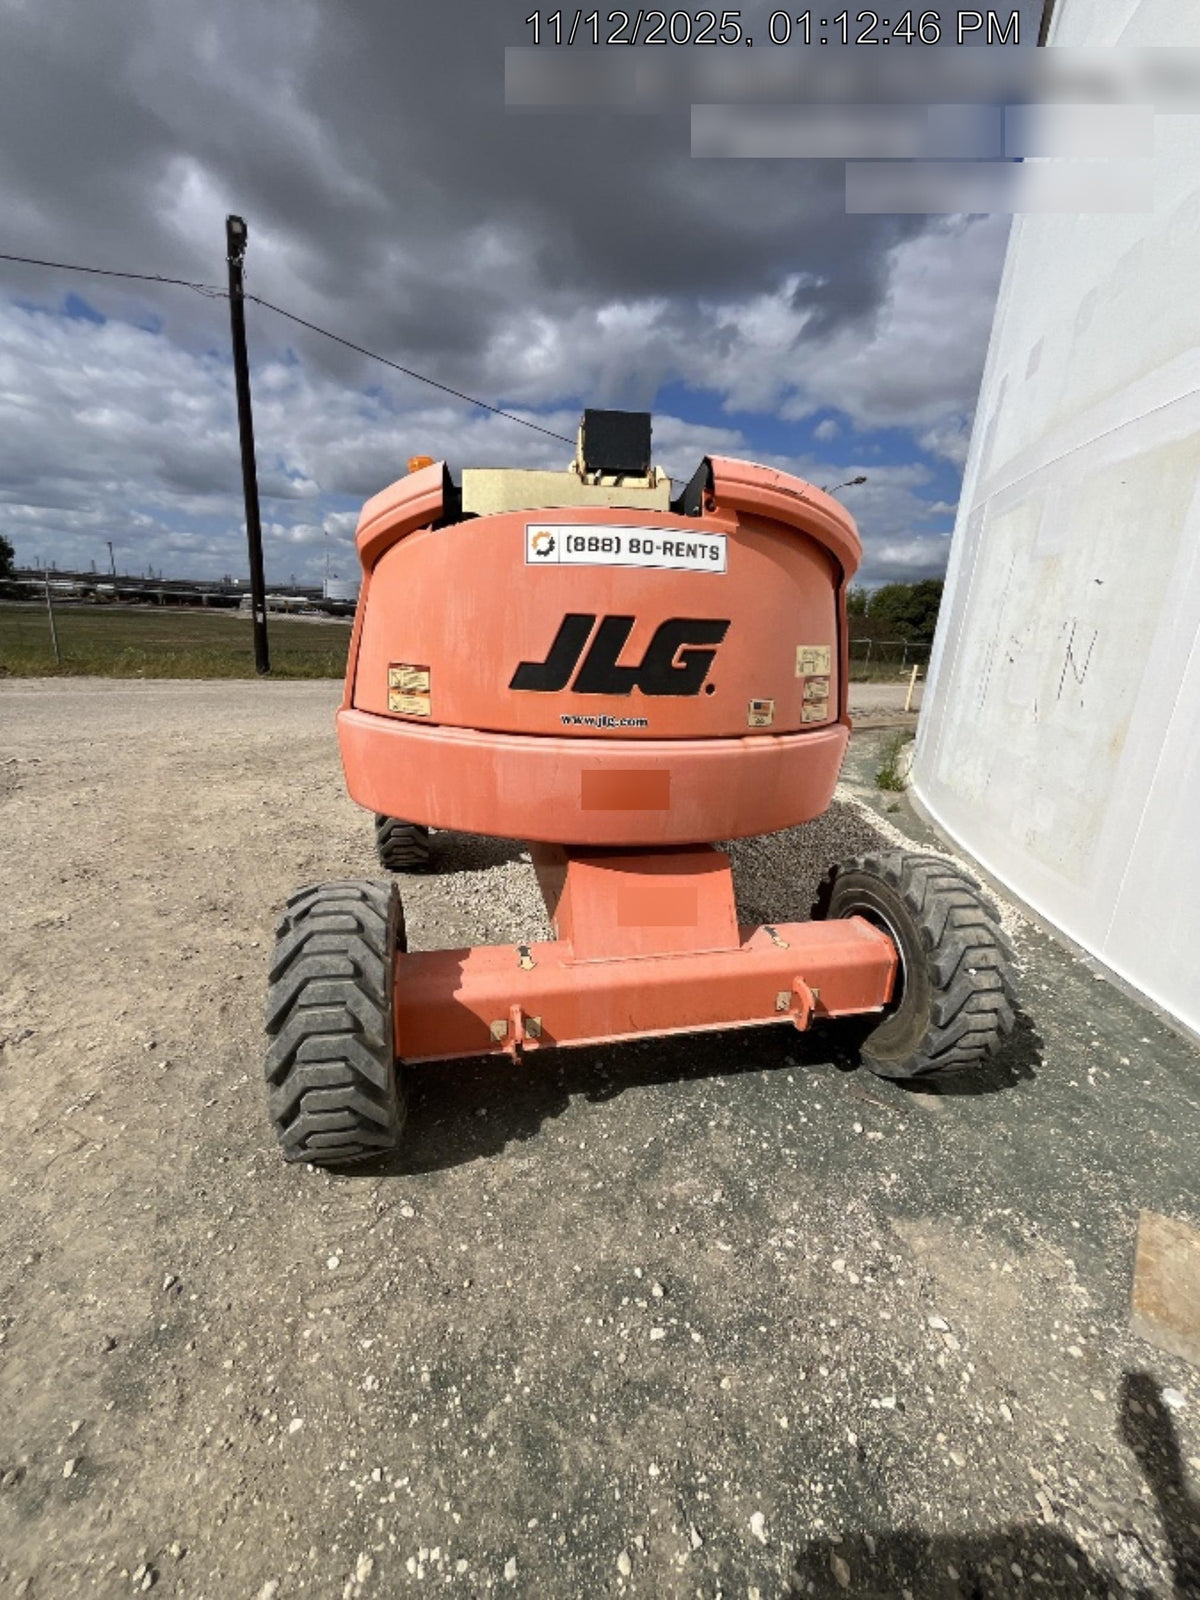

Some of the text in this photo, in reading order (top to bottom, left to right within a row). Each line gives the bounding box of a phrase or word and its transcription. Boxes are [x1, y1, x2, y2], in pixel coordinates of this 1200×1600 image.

[566, 535, 720, 561] (888) 80-RENTS
[561, 713, 648, 728] www.jlg.com
